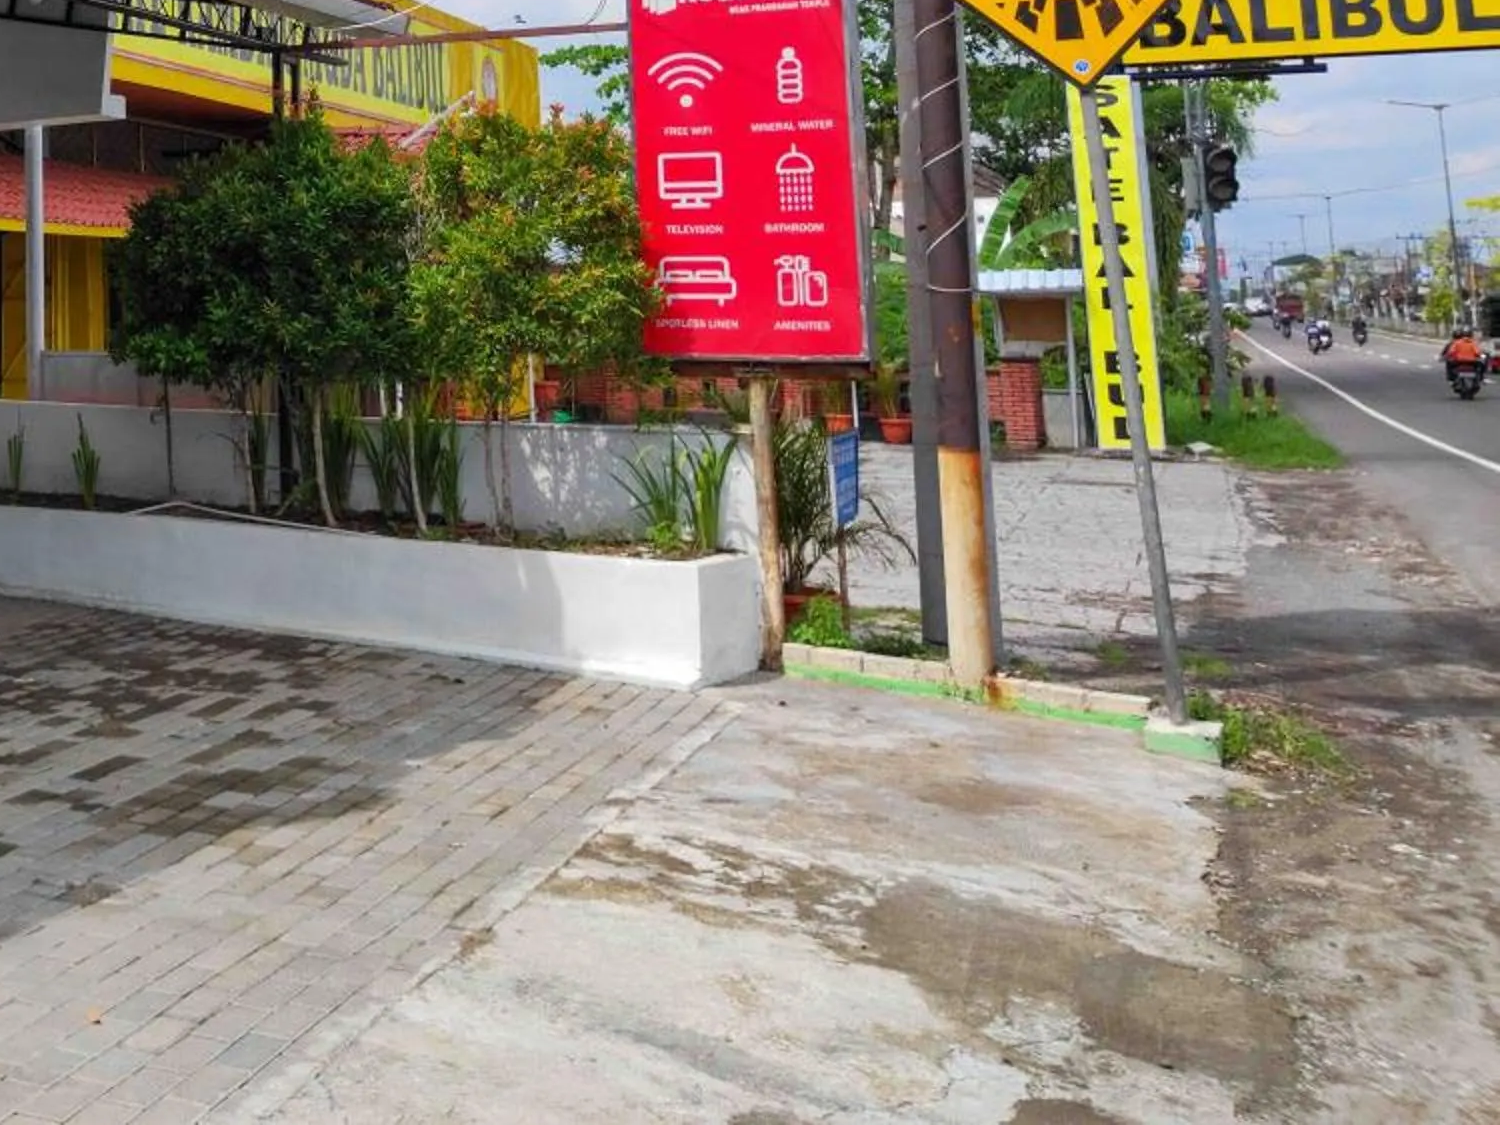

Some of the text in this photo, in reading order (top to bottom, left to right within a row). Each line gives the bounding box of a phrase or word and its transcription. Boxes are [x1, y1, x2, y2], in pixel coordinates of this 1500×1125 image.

[750, 118, 835, 134] MINERAL WATER
[665, 223, 725, 236] TELEVISION
[763, 221, 825, 234] BATHROOM
[773, 319, 832, 333] AMENITIES
